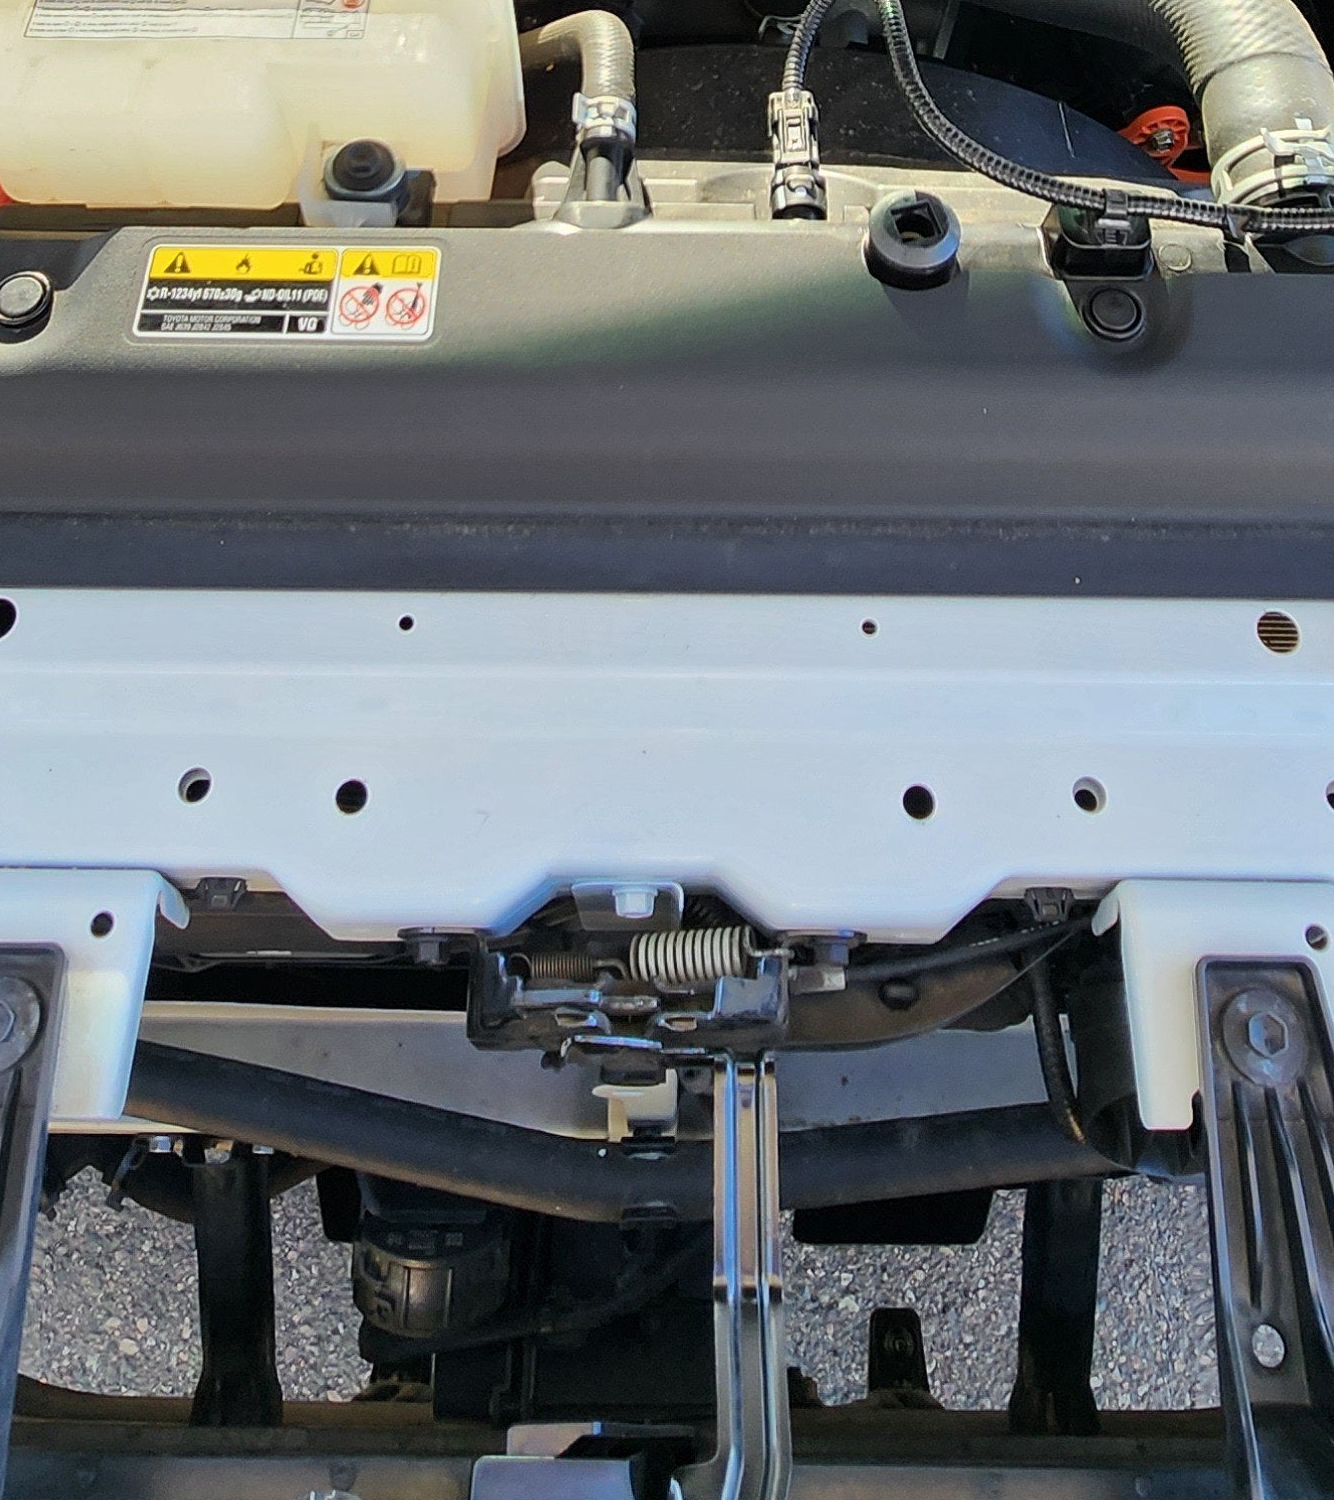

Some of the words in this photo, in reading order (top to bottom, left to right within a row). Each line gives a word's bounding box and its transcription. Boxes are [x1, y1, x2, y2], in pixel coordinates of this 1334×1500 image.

[160, 287, 202, 302] R-1234yf
[189, 315, 214, 323] MOTOR
[214, 315, 262, 325] CORPORATION
